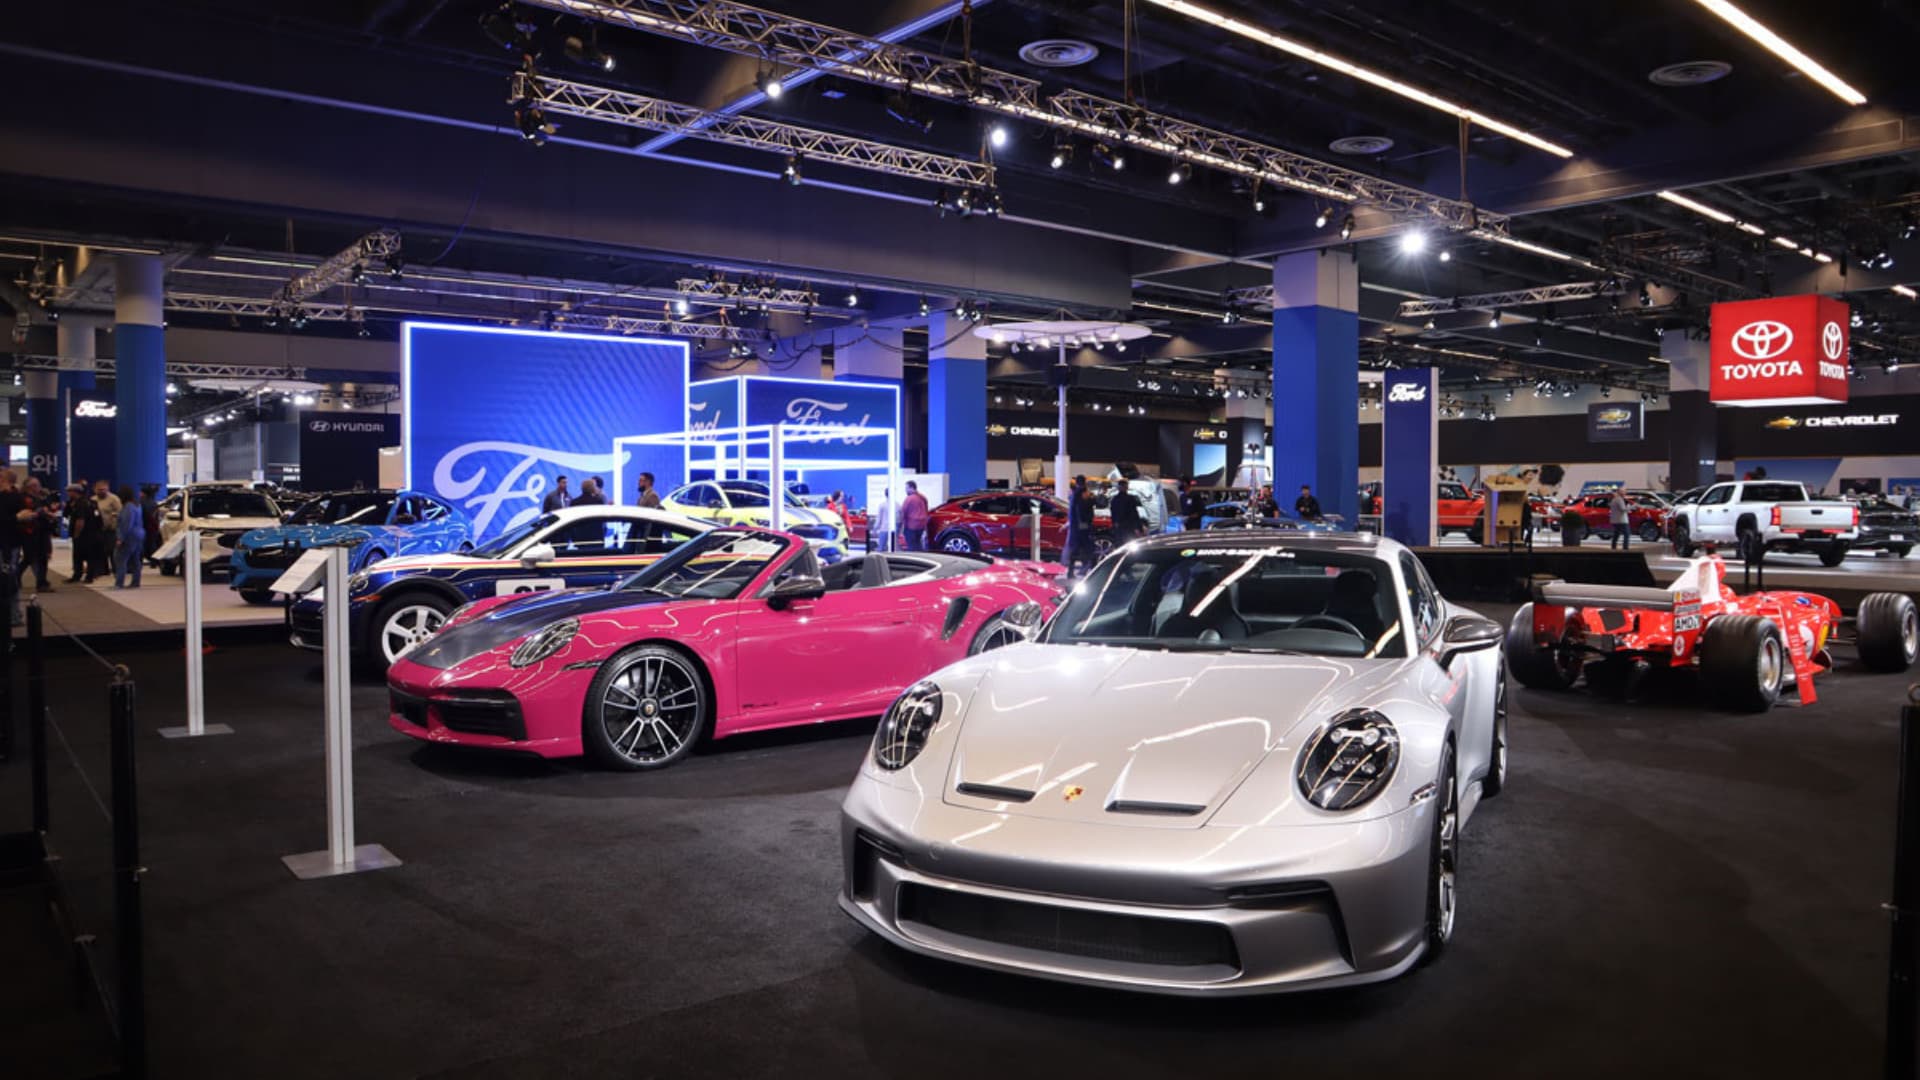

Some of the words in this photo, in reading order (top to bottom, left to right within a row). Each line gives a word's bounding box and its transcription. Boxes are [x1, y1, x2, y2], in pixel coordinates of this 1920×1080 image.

[1720, 360, 1803, 381] TOYOTA
[1818, 360, 1846, 380] TOYOTA
[1388, 383, 1426, 402] Ford
[75, 400, 118, 418] Ford
[332, 422, 385, 432] HYUNDAI
[1805, 414, 1899, 427] CHEVROLET
[32, 454, 58, 476] 와!
